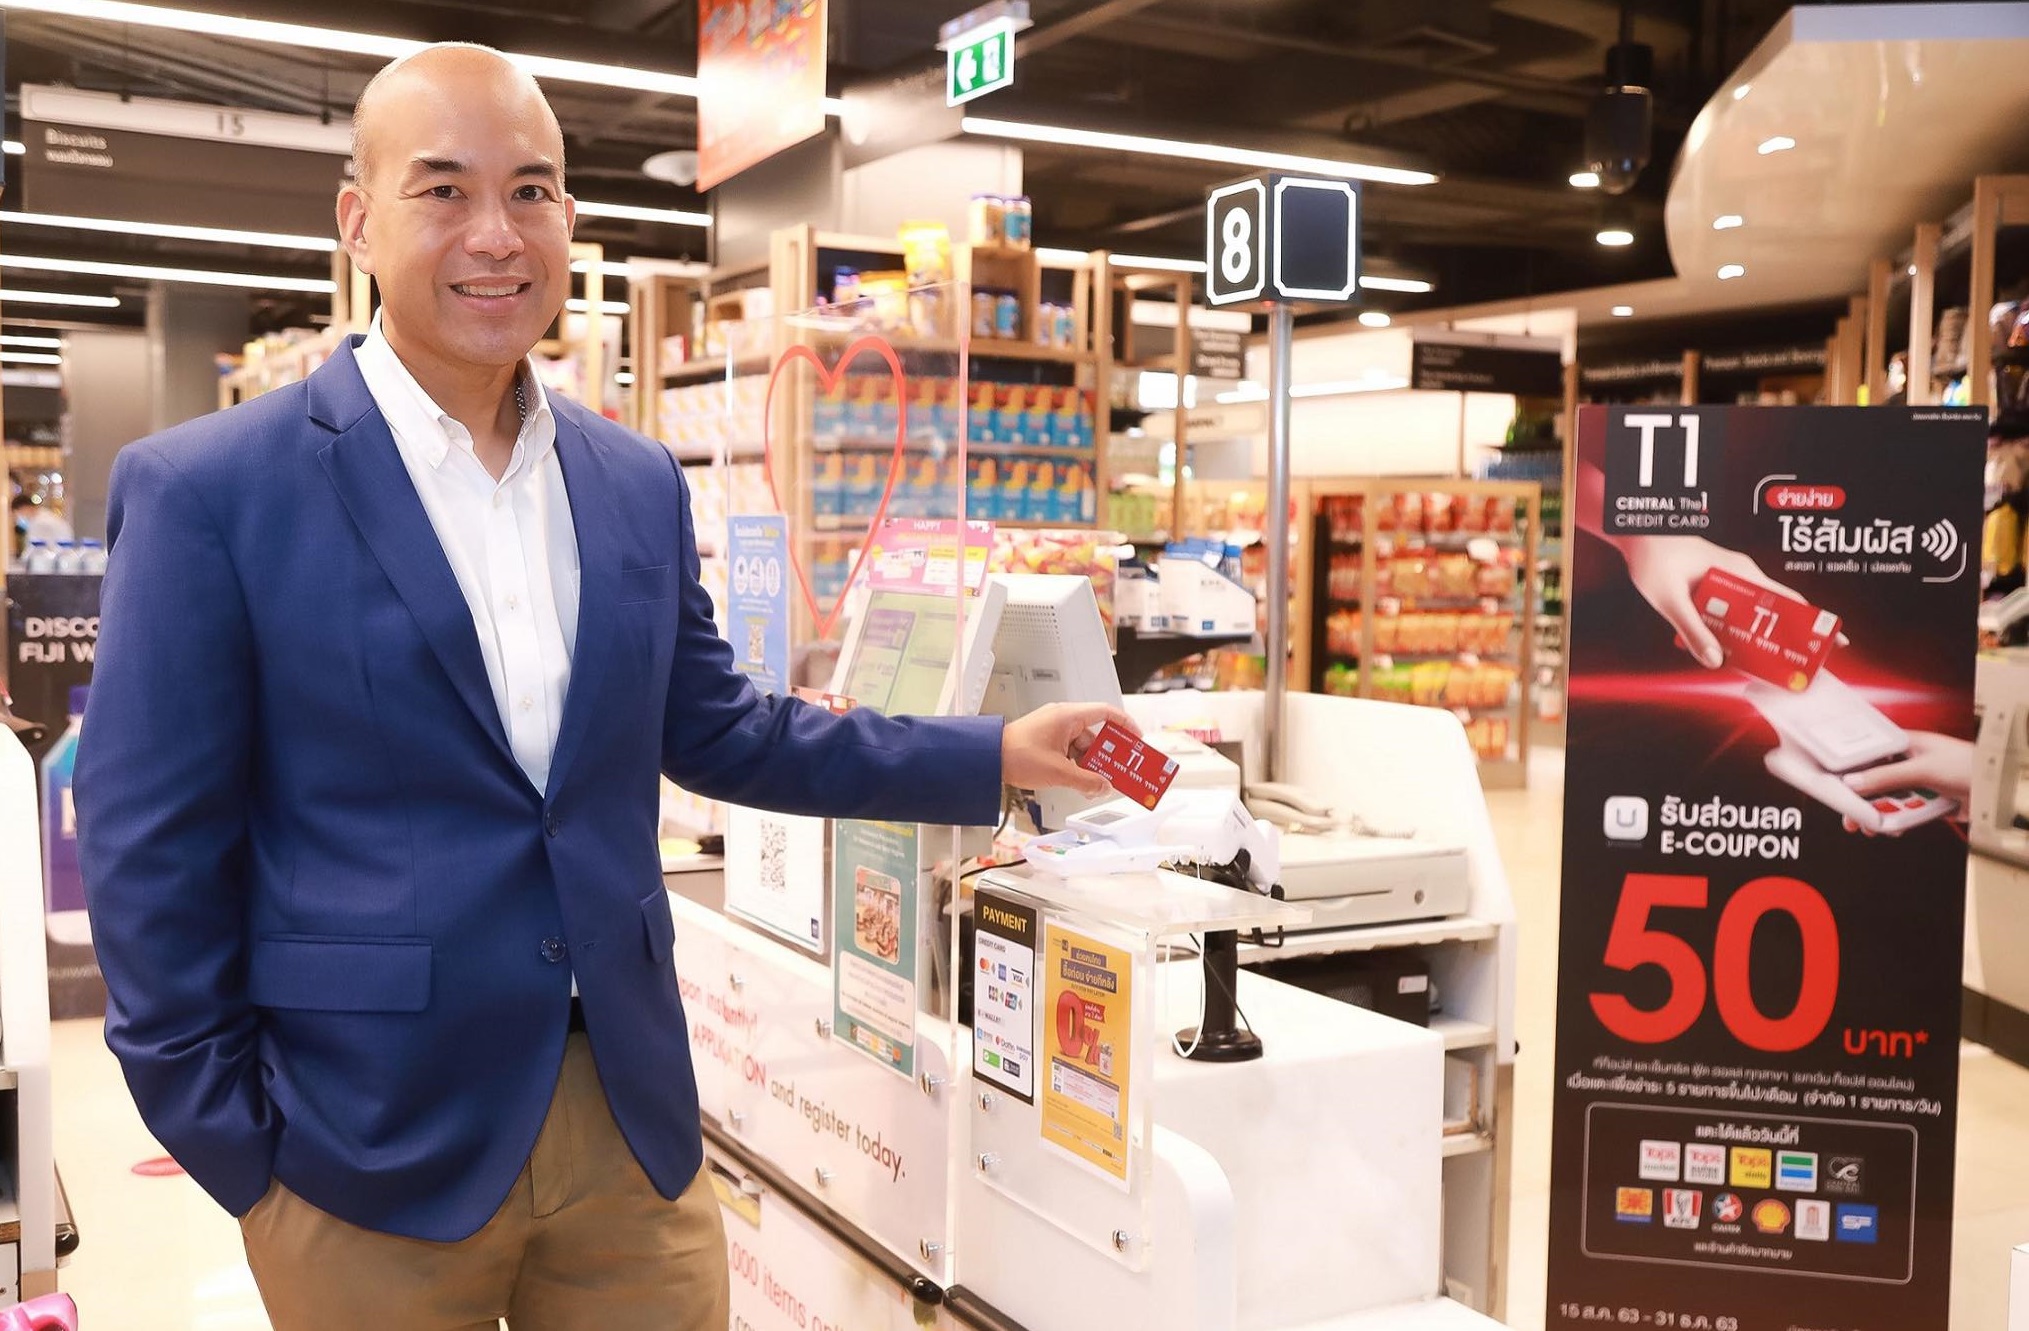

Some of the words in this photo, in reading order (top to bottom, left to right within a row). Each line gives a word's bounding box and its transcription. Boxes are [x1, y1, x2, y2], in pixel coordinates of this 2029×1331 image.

[1221, 206, 1252, 284] 8
[1623, 413, 1701, 488] T1
[1615, 496, 1676, 512] CENTRAL
[1776, 487, 1835, 508] จ่ายง่าย
[913, 520, 942, 531] HAPPY
[1614, 513, 1665, 528] CREDIT
[1667, 514, 1711, 529] CARD
[1777, 515, 1916, 555] ไร้สัมผัส
[19, 641, 66, 663] FIJI
[1126, 748, 1145, 772] T1
[1660, 794, 1802, 831] รับส่วนลด
[1660, 830, 1800, 860] E-COUPON
[983, 905, 1028, 934] PAYMENT
[1588, 872, 1840, 1053] 50
[1849, 1095, 1857, 1109] 1
[771, 1080, 795, 1108] and
[800, 1095, 850, 1142] register
[856, 1124, 905, 1183] today.
[764, 1265, 807, 1330] items
[1560, 1303, 1580, 1319] 15
[1617, 1307, 1640, 1324] 63
[1654, 1310, 1675, 1327] 31
[1715, 1316, 1739, 1331] 63
